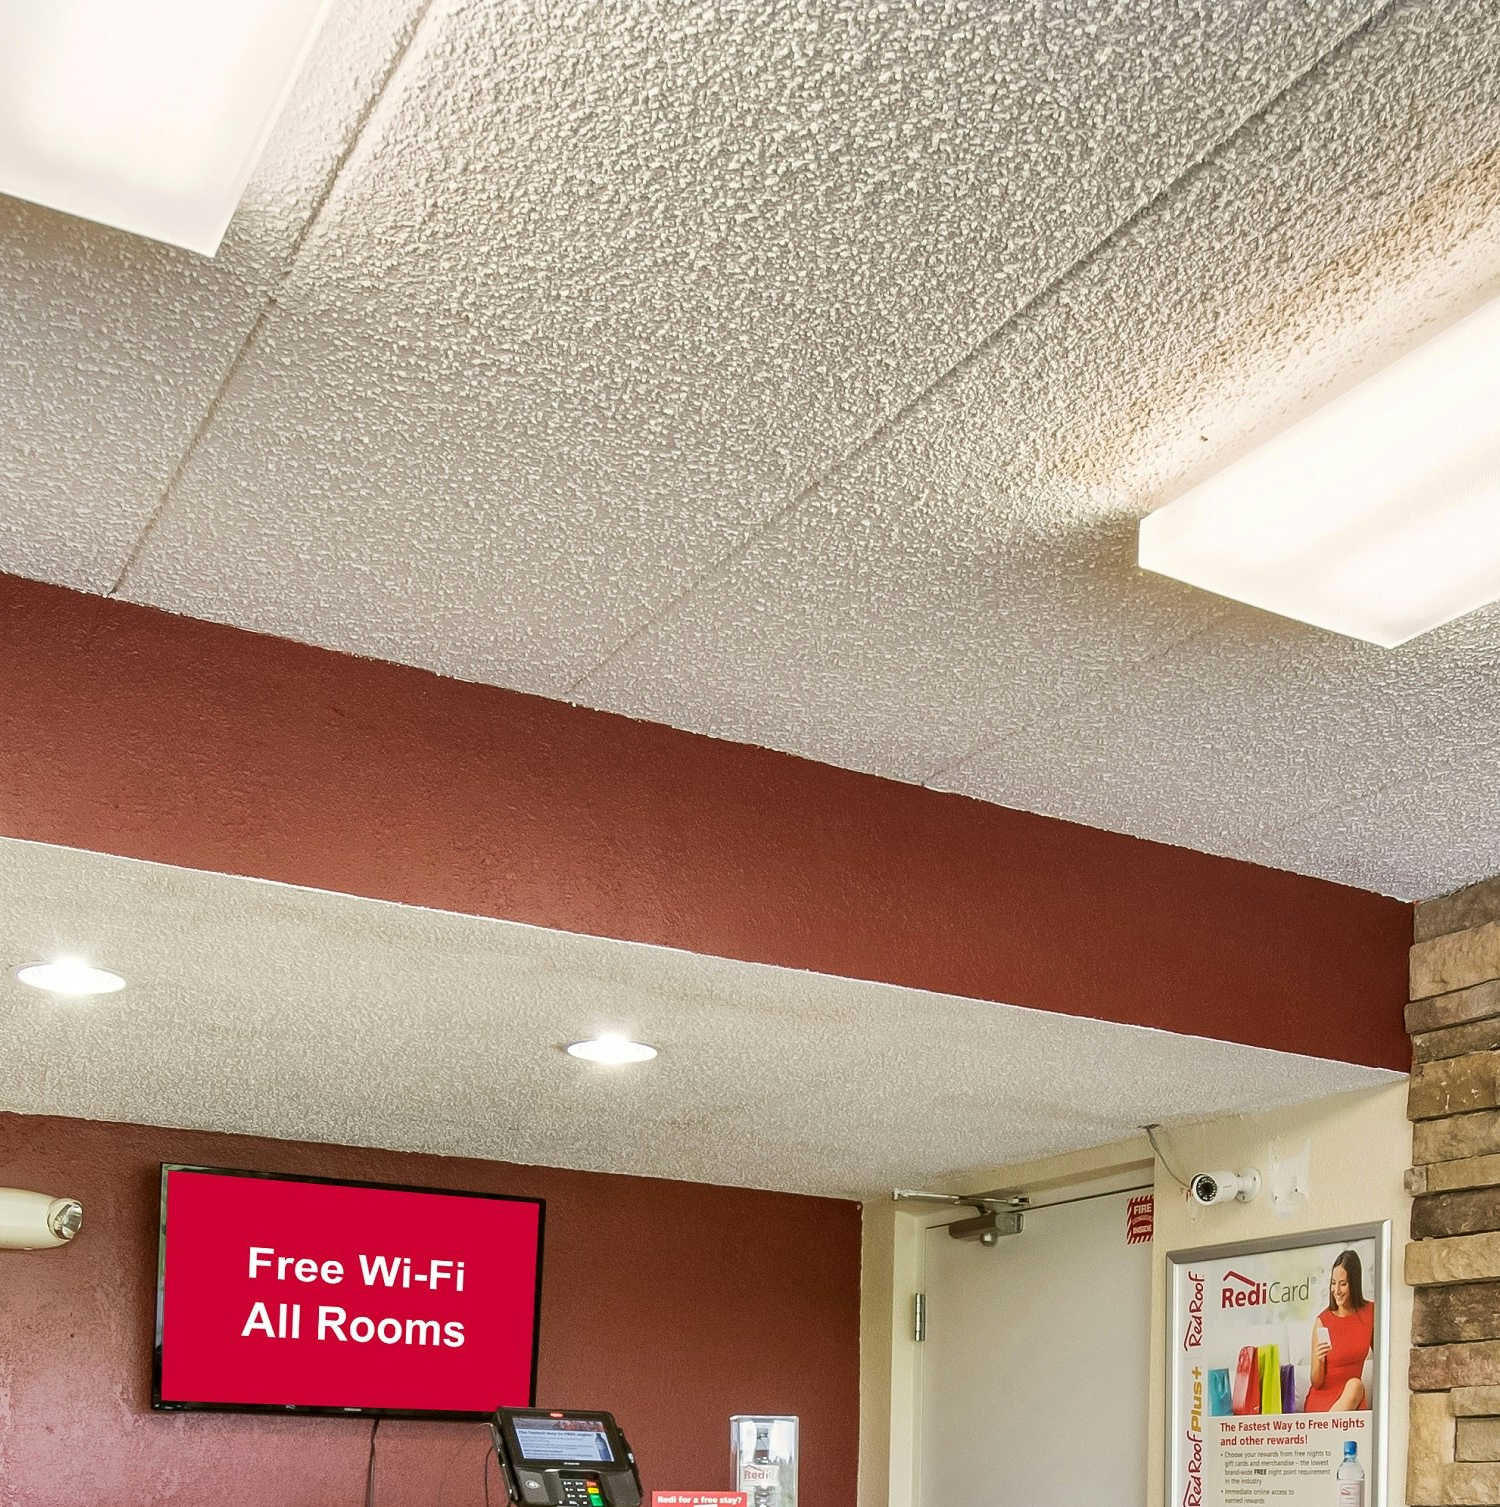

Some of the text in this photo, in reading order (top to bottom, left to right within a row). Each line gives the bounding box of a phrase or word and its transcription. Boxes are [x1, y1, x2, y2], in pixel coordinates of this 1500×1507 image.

[1133, 1203, 1152, 1215] FIRE
[248, 1246, 465, 1292] Free Wi-Fi
[240, 1301, 465, 1348] All Rooms
[1220, 1417, 1365, 1433] The Fastest Way to Free Nights
[1220, 1434, 1308, 1446] and other rewards!
[744, 1470, 769, 1480] Redi
[657, 1495, 742, 1505] Redi for a free stay?
